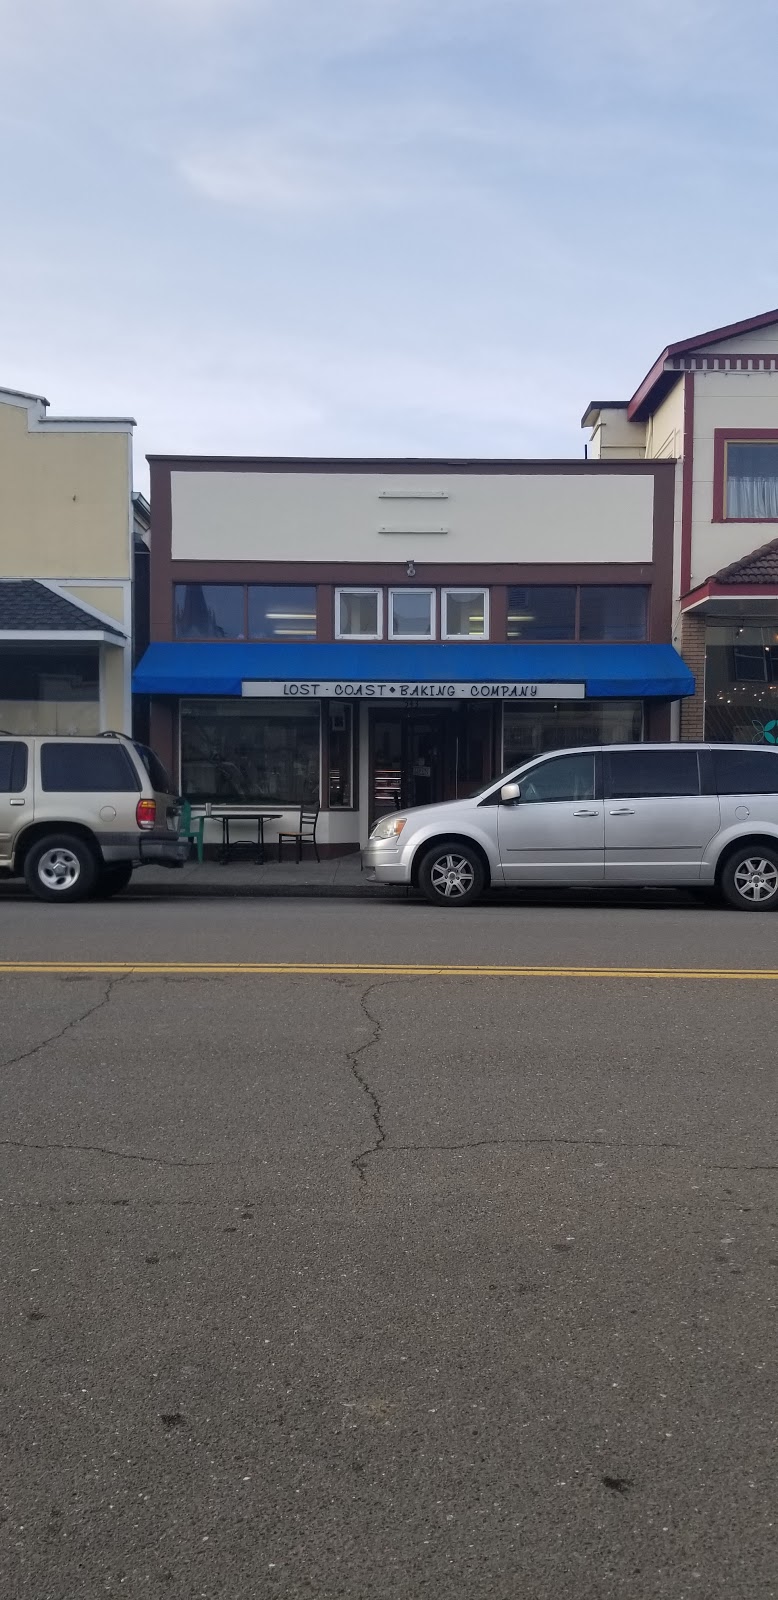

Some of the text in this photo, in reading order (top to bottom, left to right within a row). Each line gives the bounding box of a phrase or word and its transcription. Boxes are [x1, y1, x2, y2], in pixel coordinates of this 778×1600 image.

[283, 684, 538, 697] LOST COAST BAKING COMPANY
